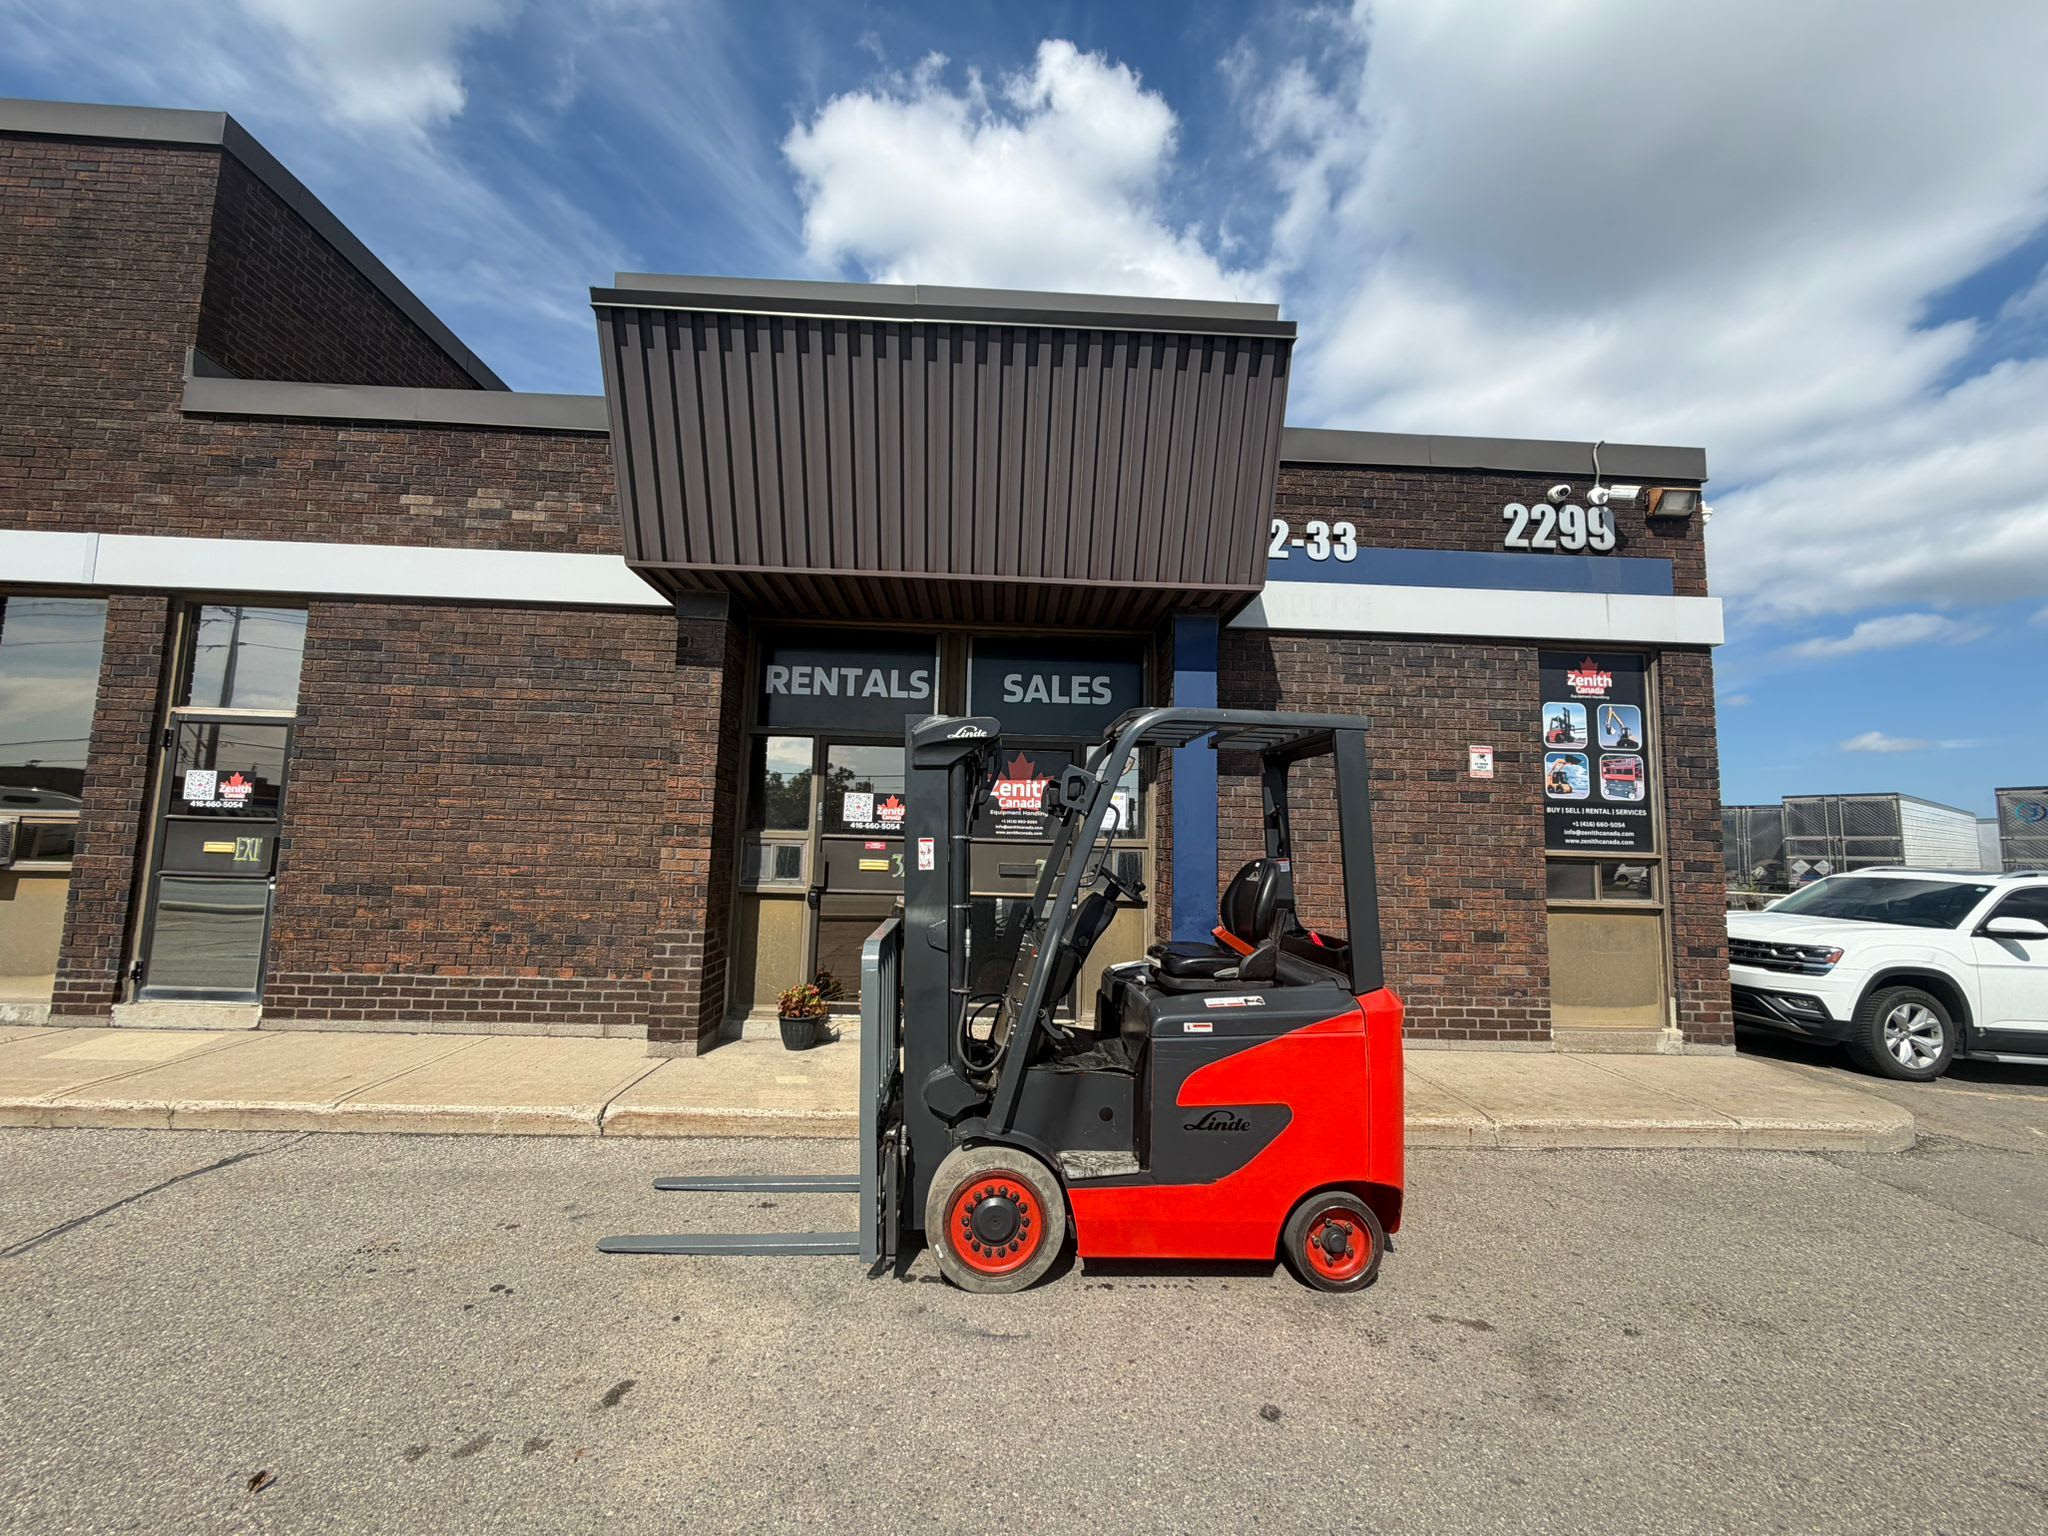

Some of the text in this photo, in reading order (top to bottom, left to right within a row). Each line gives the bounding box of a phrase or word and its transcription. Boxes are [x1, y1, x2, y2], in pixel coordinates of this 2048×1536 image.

[1503, 503, 1616, 551] 2299
[766, 665, 930, 699] RENTALS
[1567, 673, 1612, 687] Zenith
[1003, 673, 1112, 705] SALES
[1575, 686, 1605, 694] Canada
[947, 725, 988, 738] Linde
[219, 784, 252, 794] Zenith
[190, 800, 243, 808] 416-660-5054
[998, 797, 1041, 809] Canada
[990, 809, 1021, 817] Equipment
[1546, 806, 1561, 814] BUY
[850, 822, 901, 830] 416-660-5054
[1564, 829, 1635, 837] info@zenithcanada.com
[1565, 838, 1635, 846] www.zenithcanada.com
[892, 853, 905, 878] 3
[1183, 1109, 1251, 1131] Linde
